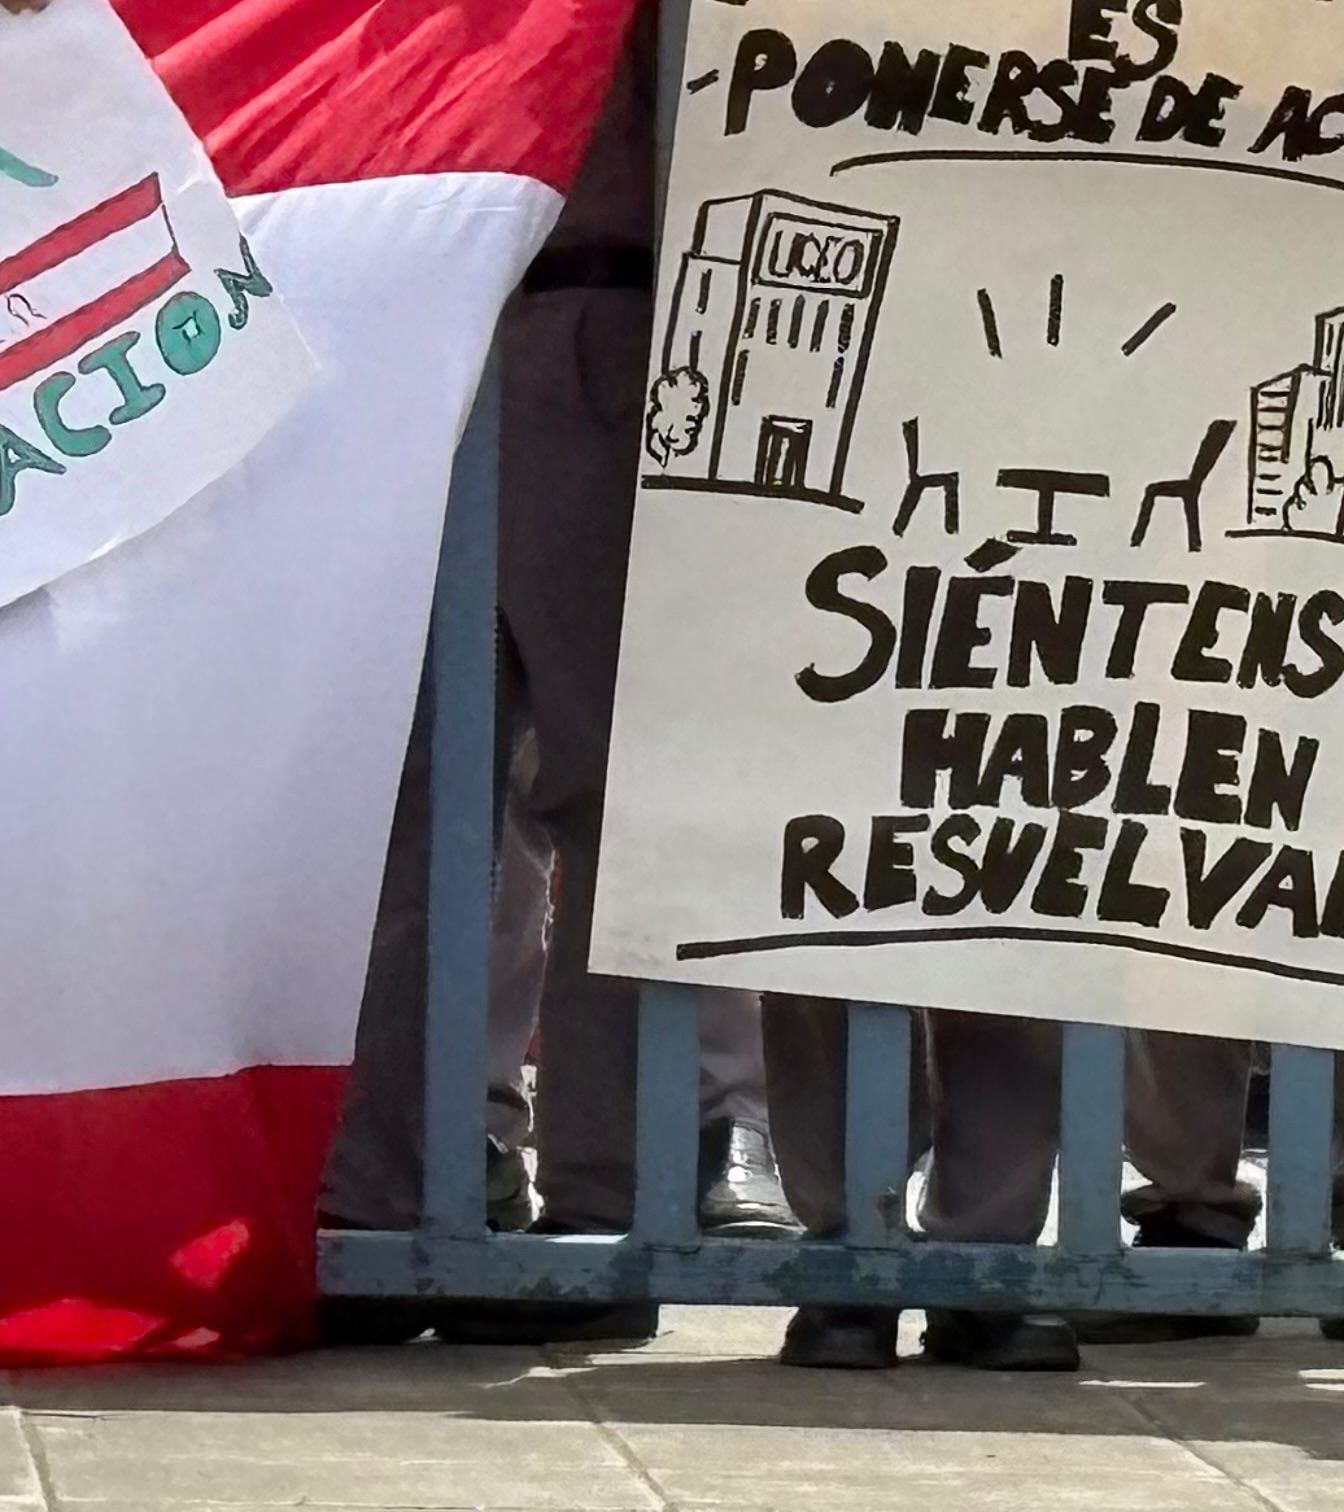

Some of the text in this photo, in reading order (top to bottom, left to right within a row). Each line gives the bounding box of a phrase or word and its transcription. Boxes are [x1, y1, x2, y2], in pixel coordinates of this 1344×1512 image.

[724, 28, 1116, 143] PONERSE
[1135, 76, 1242, 148] DE
[900, 703, 1318, 832] HABLEN
